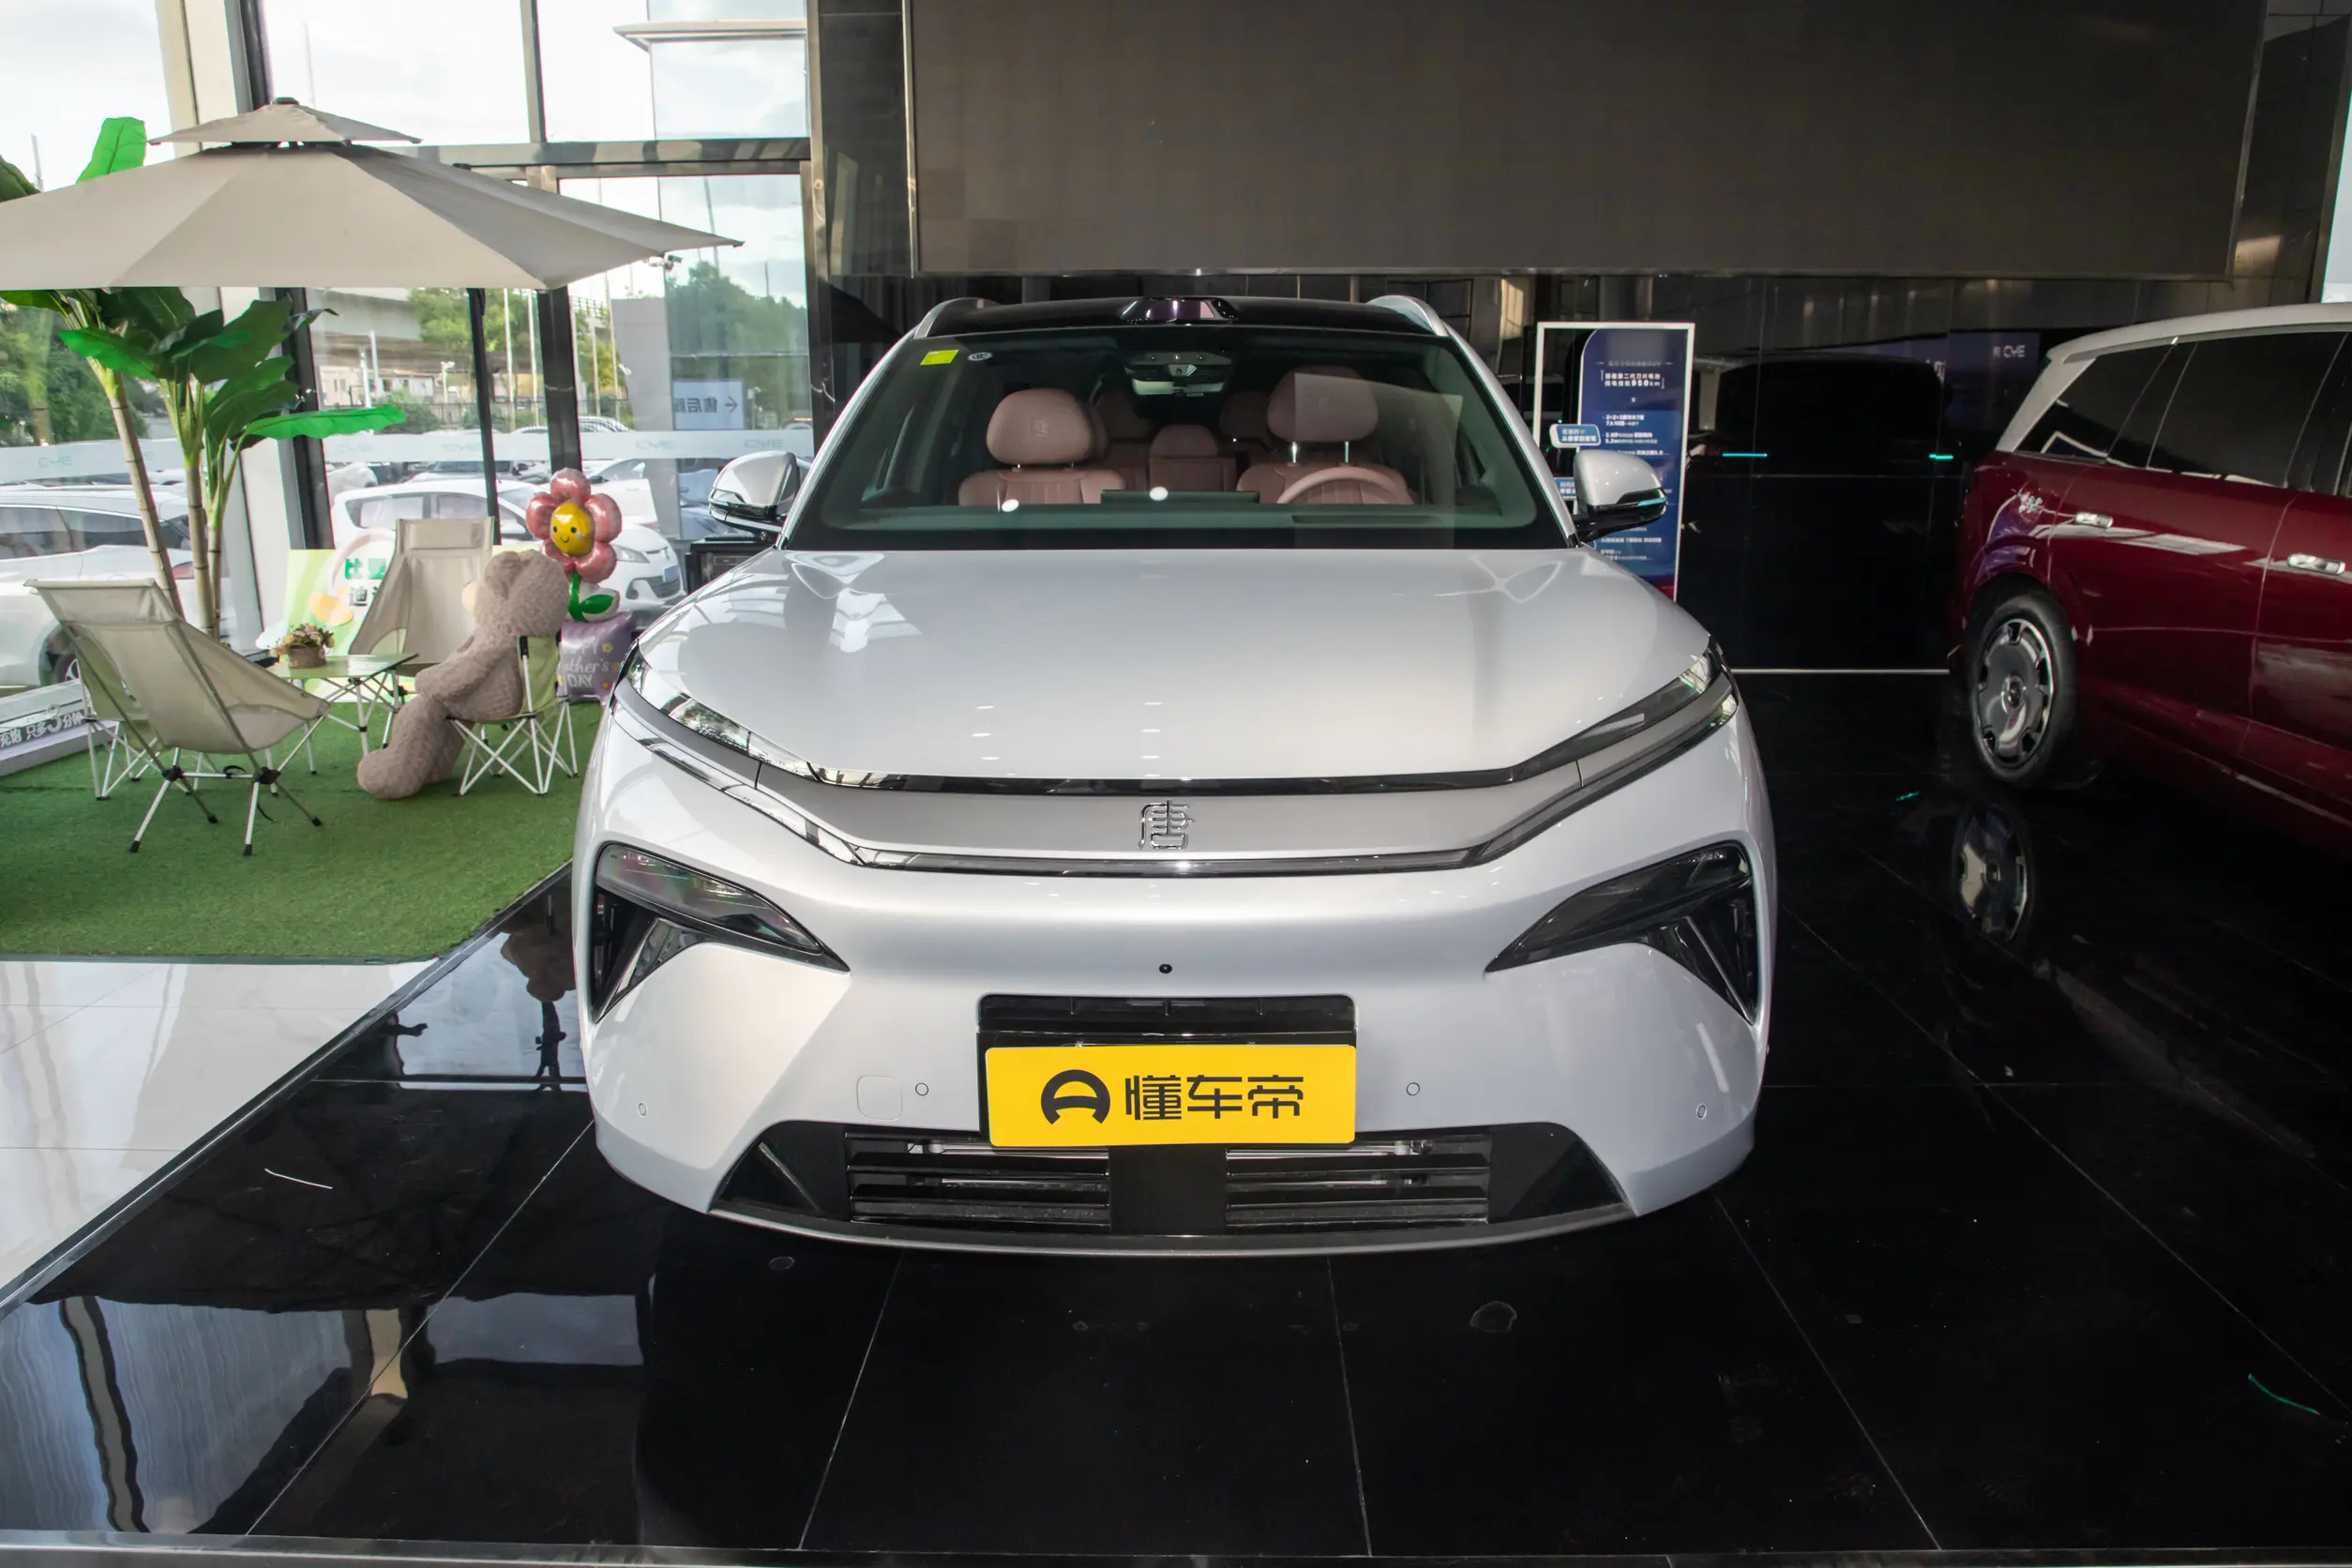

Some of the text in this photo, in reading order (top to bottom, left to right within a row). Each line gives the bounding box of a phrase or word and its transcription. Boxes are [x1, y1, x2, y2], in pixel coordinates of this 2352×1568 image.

[566, 672, 593, 687] DAY
[1138, 799, 1196, 851] 唐
[1123, 1074, 1304, 1121] 懂车帝
